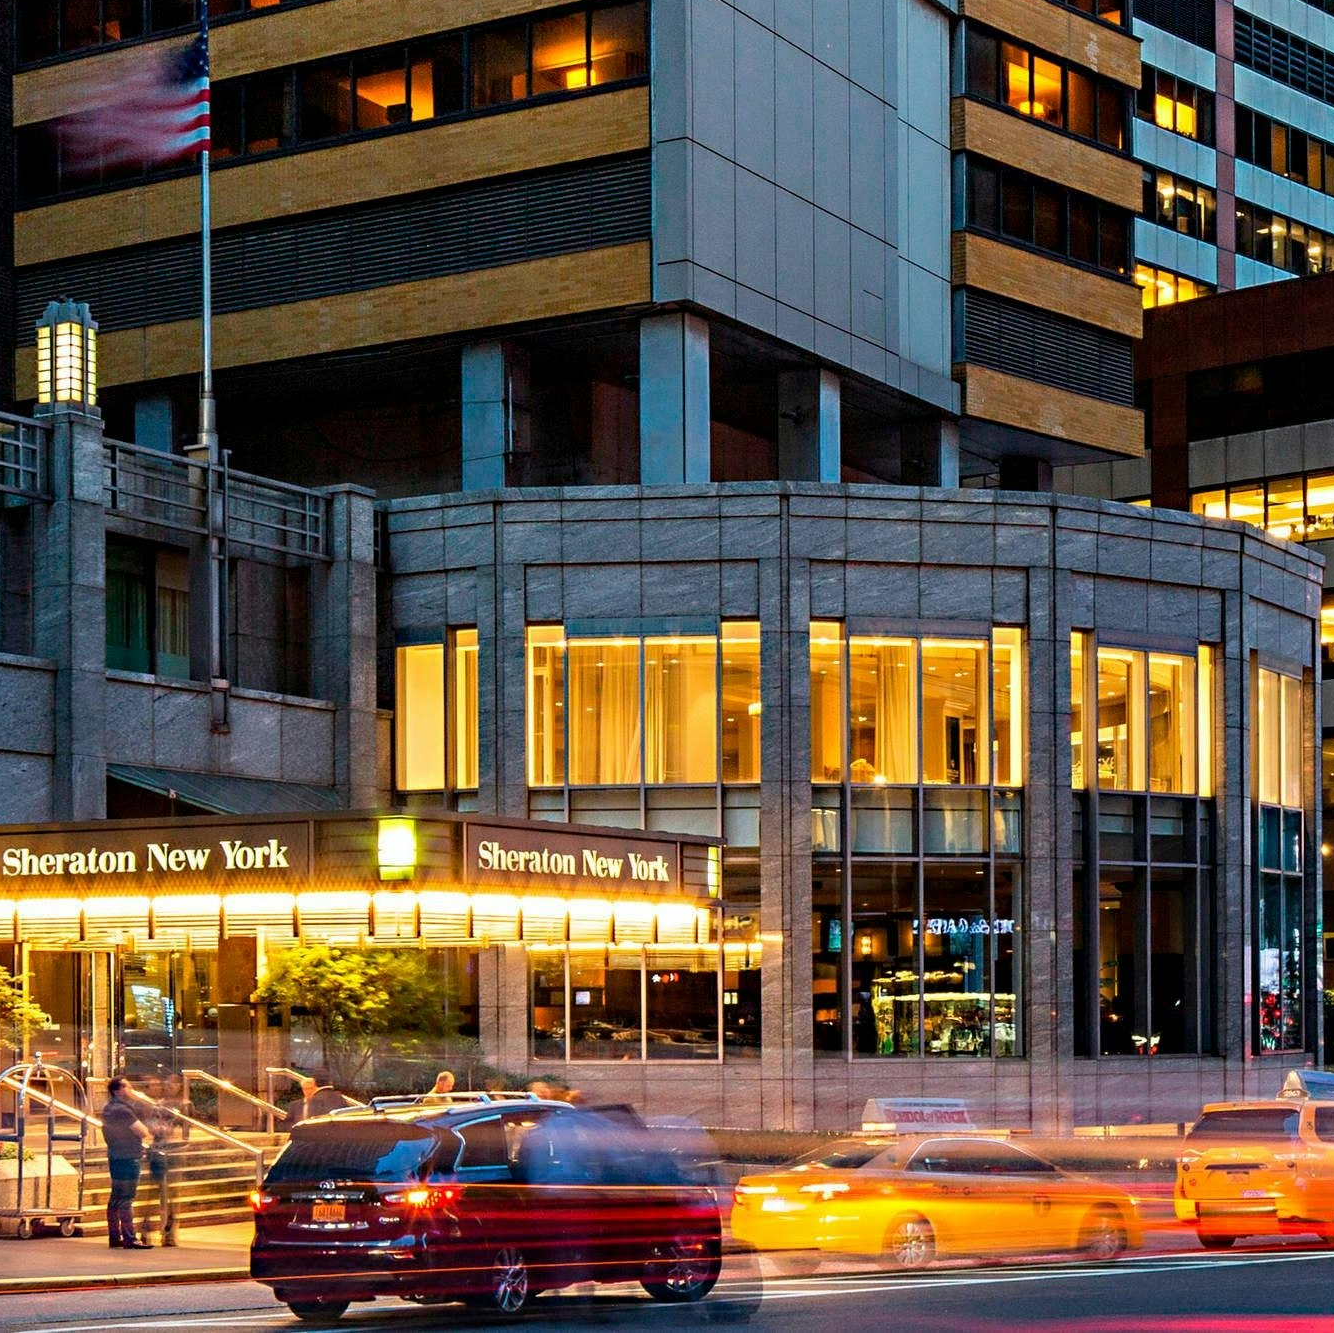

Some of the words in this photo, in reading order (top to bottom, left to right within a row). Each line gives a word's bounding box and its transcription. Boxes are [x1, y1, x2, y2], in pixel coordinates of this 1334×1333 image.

[2, 847, 137, 876] Sheraton
[146, 842, 211, 872] New
[219, 839, 290, 870] York
[478, 840, 576, 875] Sheraton
[582, 849, 624, 879] New
[627, 852, 670, 882] York
